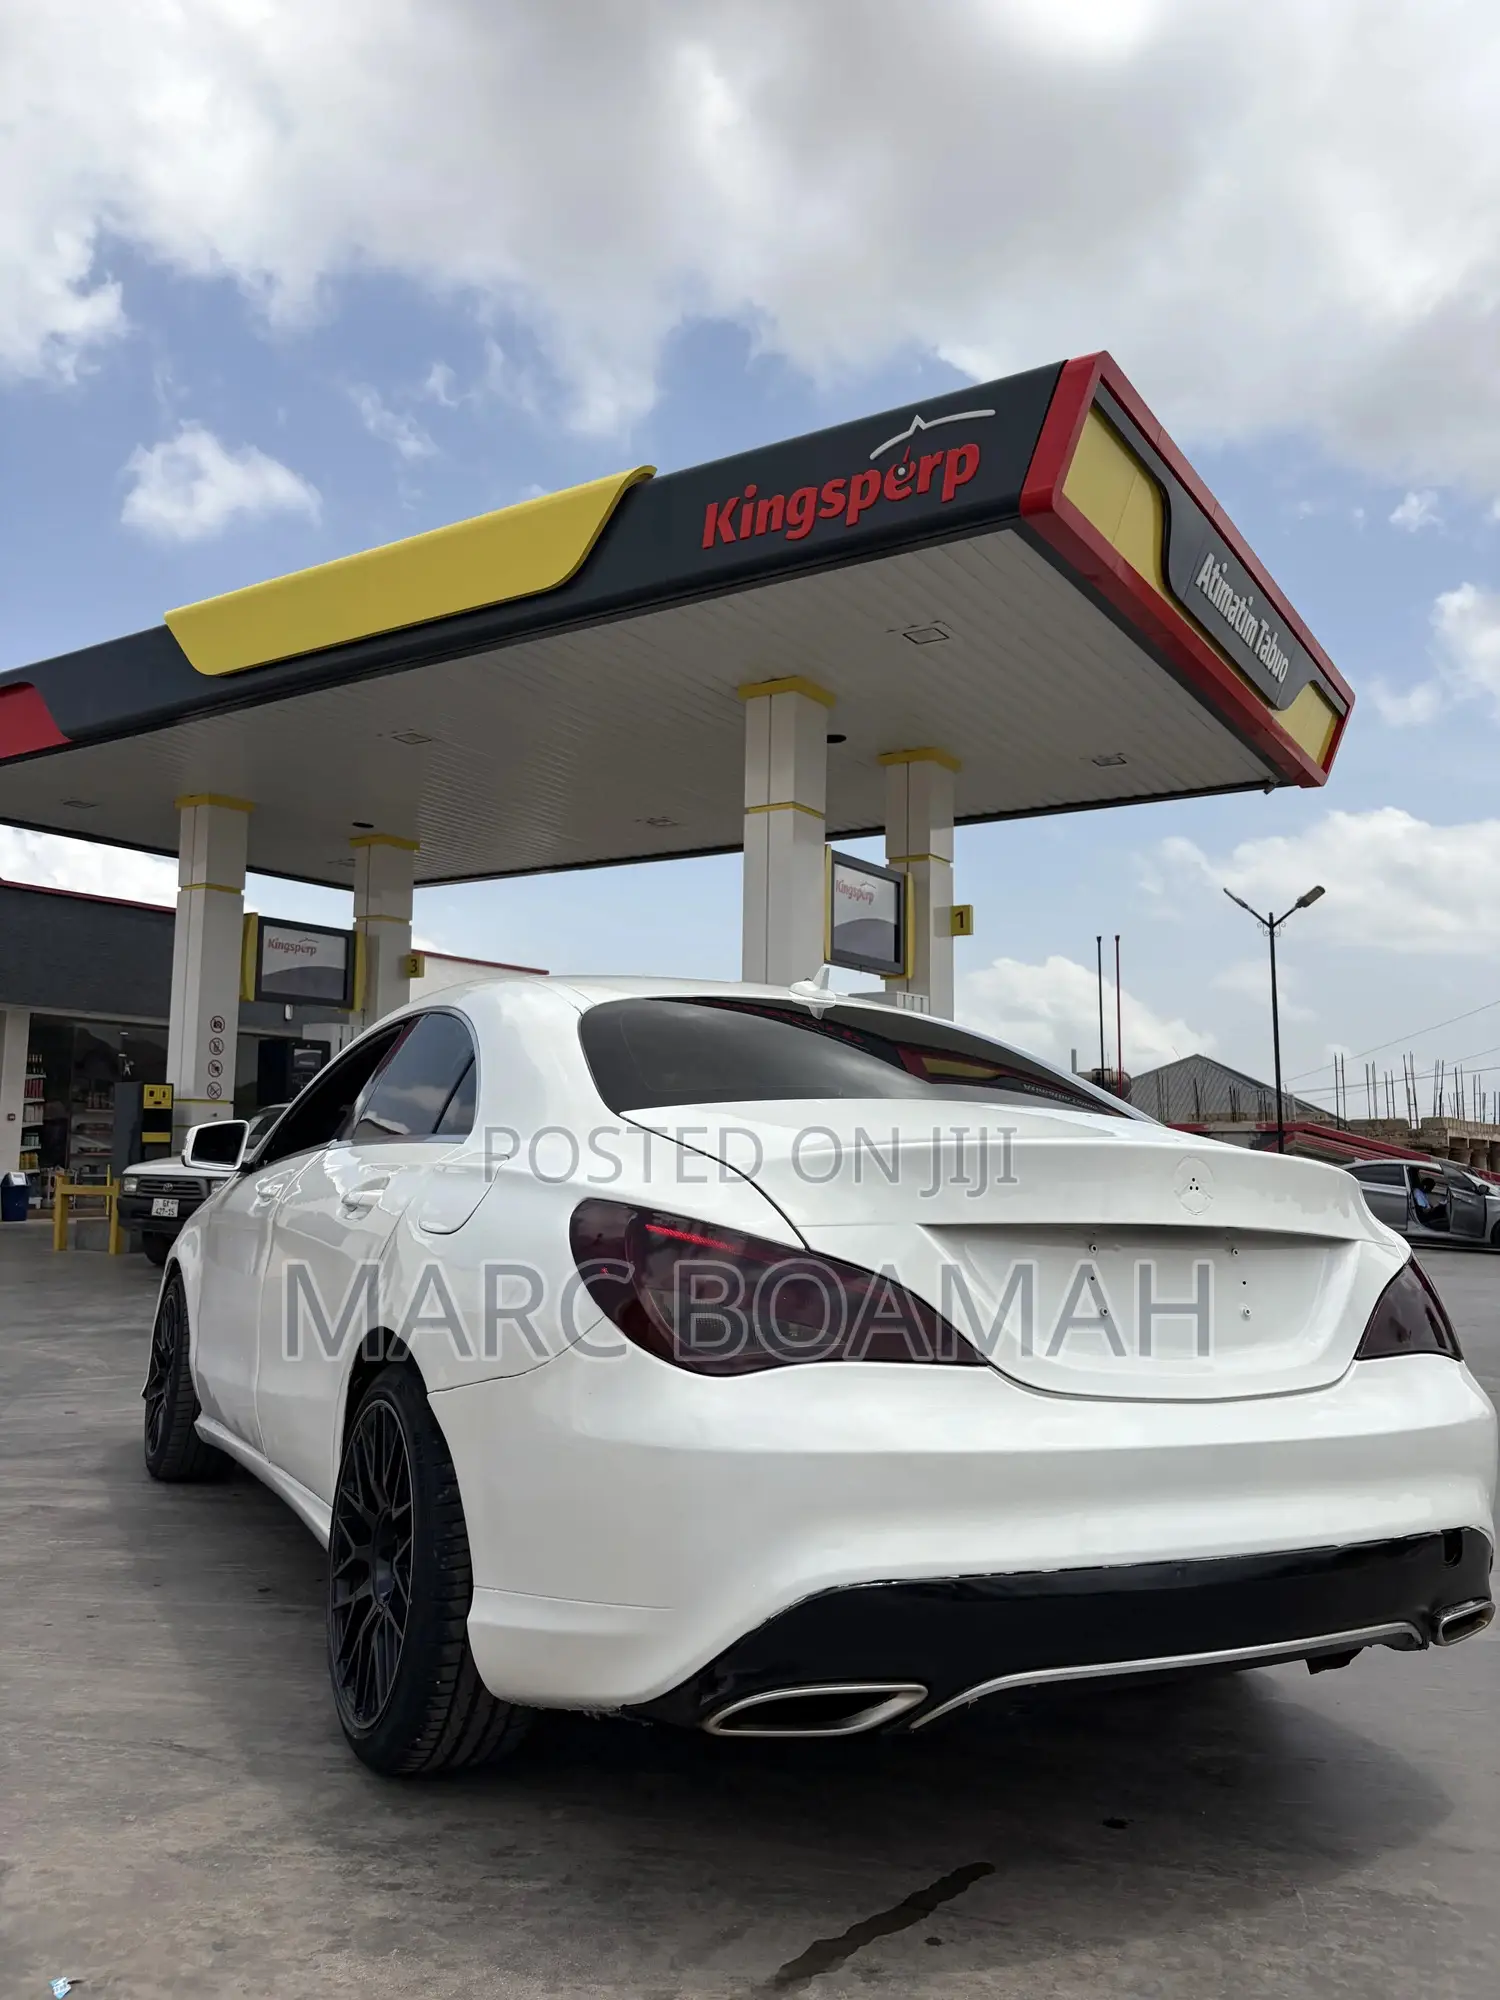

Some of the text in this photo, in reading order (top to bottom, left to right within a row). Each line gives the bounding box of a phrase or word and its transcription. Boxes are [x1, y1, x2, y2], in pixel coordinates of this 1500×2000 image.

[702, 444, 981, 549] Kingsperp
[1195, 552, 1289, 683] Atimatim Tabuo
[955, 911, 964, 928] 1
[411, 958, 418, 973] 3
